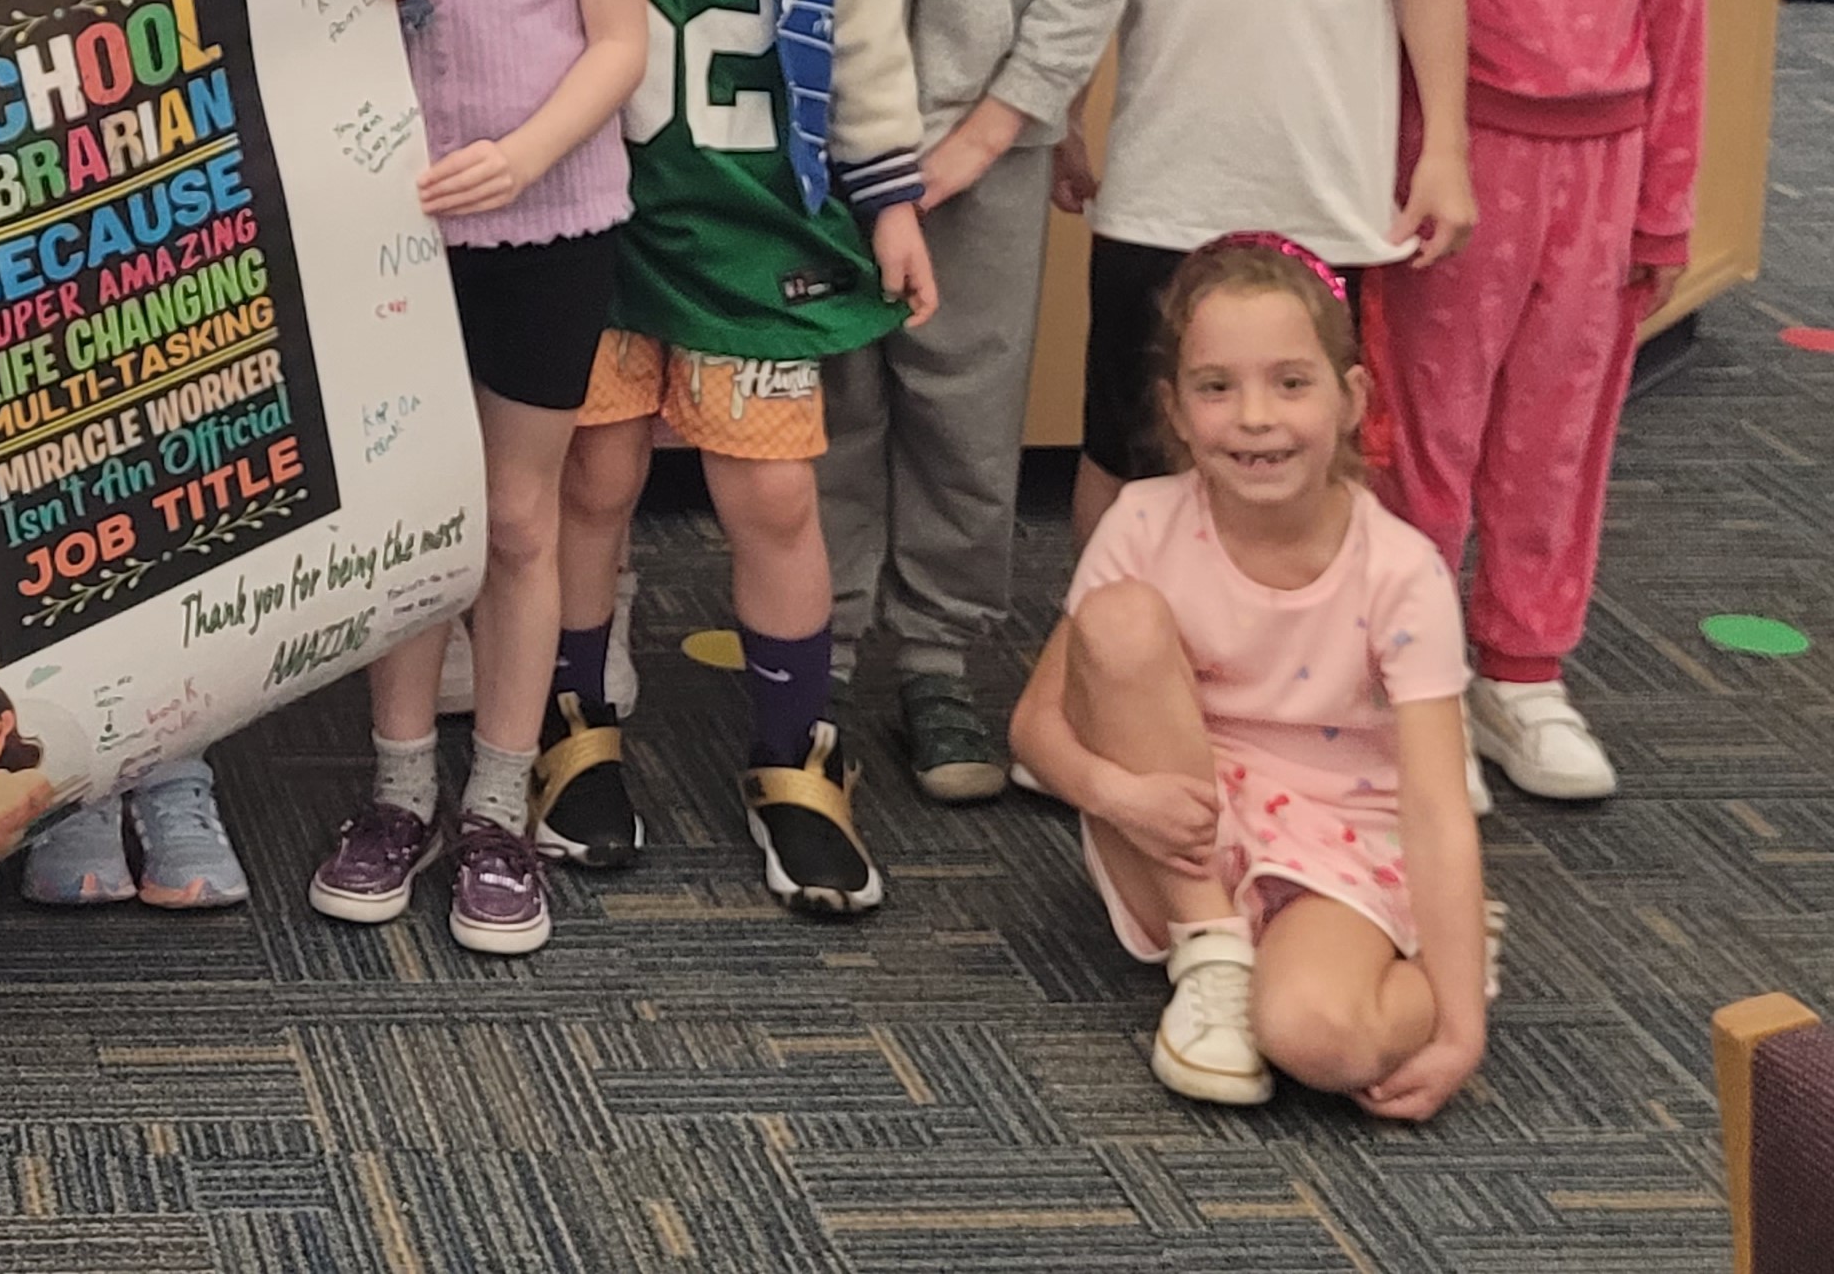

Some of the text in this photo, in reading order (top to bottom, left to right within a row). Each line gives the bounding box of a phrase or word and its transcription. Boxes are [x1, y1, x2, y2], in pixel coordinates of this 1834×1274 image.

[65, 247, 268, 373] CHANGING
[99, 207, 258, 306] AMAZING
[91, 455, 157, 505] An
[158, 382, 293, 478] Official
[145, 347, 286, 437] WORKER
[17, 512, 137, 599] JOB
[153, 435, 304, 533] TITLE
[181, 574, 247, 649] Thank
[248, 582, 286, 636] you
[327, 542, 377, 591] being
[383, 518, 415, 572] the
